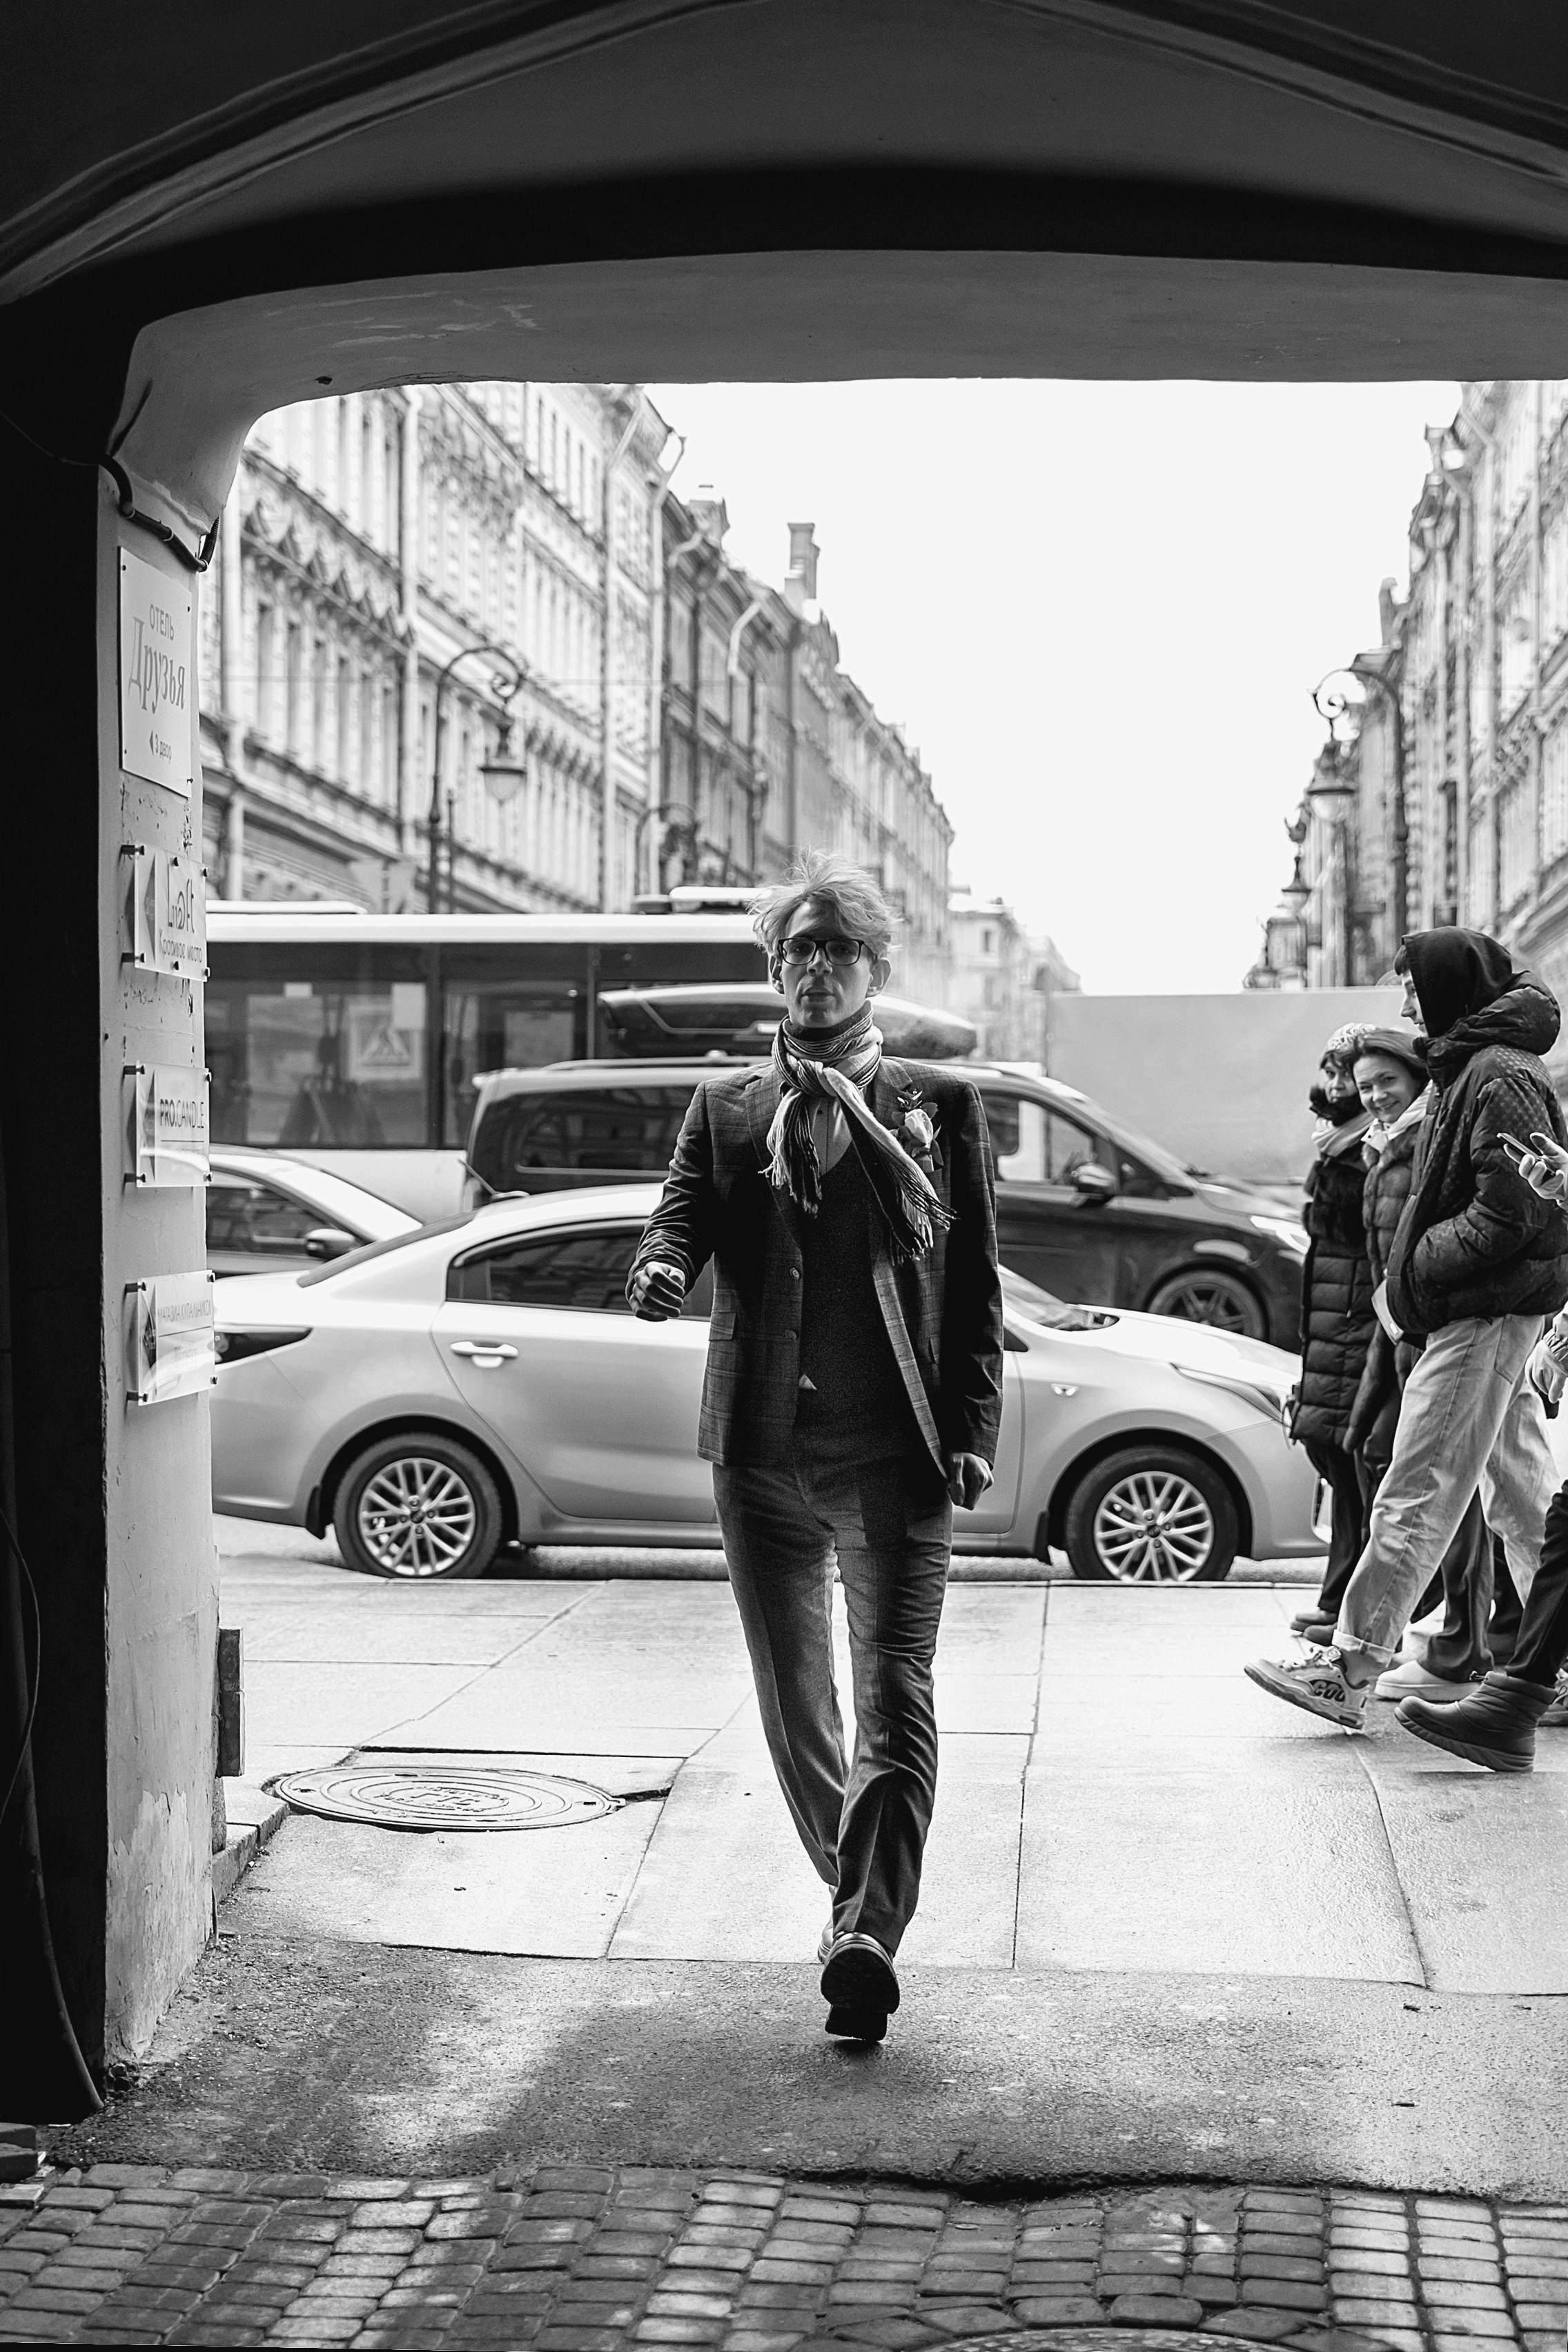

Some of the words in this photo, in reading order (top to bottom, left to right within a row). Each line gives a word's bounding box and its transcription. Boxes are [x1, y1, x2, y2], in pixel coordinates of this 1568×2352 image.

[149, 604, 175, 641] ОТЕЛЬ
[128, 616, 186, 714] Друзья
[155, 734, 159, 754] 3
[159, 741, 173, 765] двор
[188, 946, 203, 963] место
[160, 1099, 204, 1128] PRO.CANDLE
